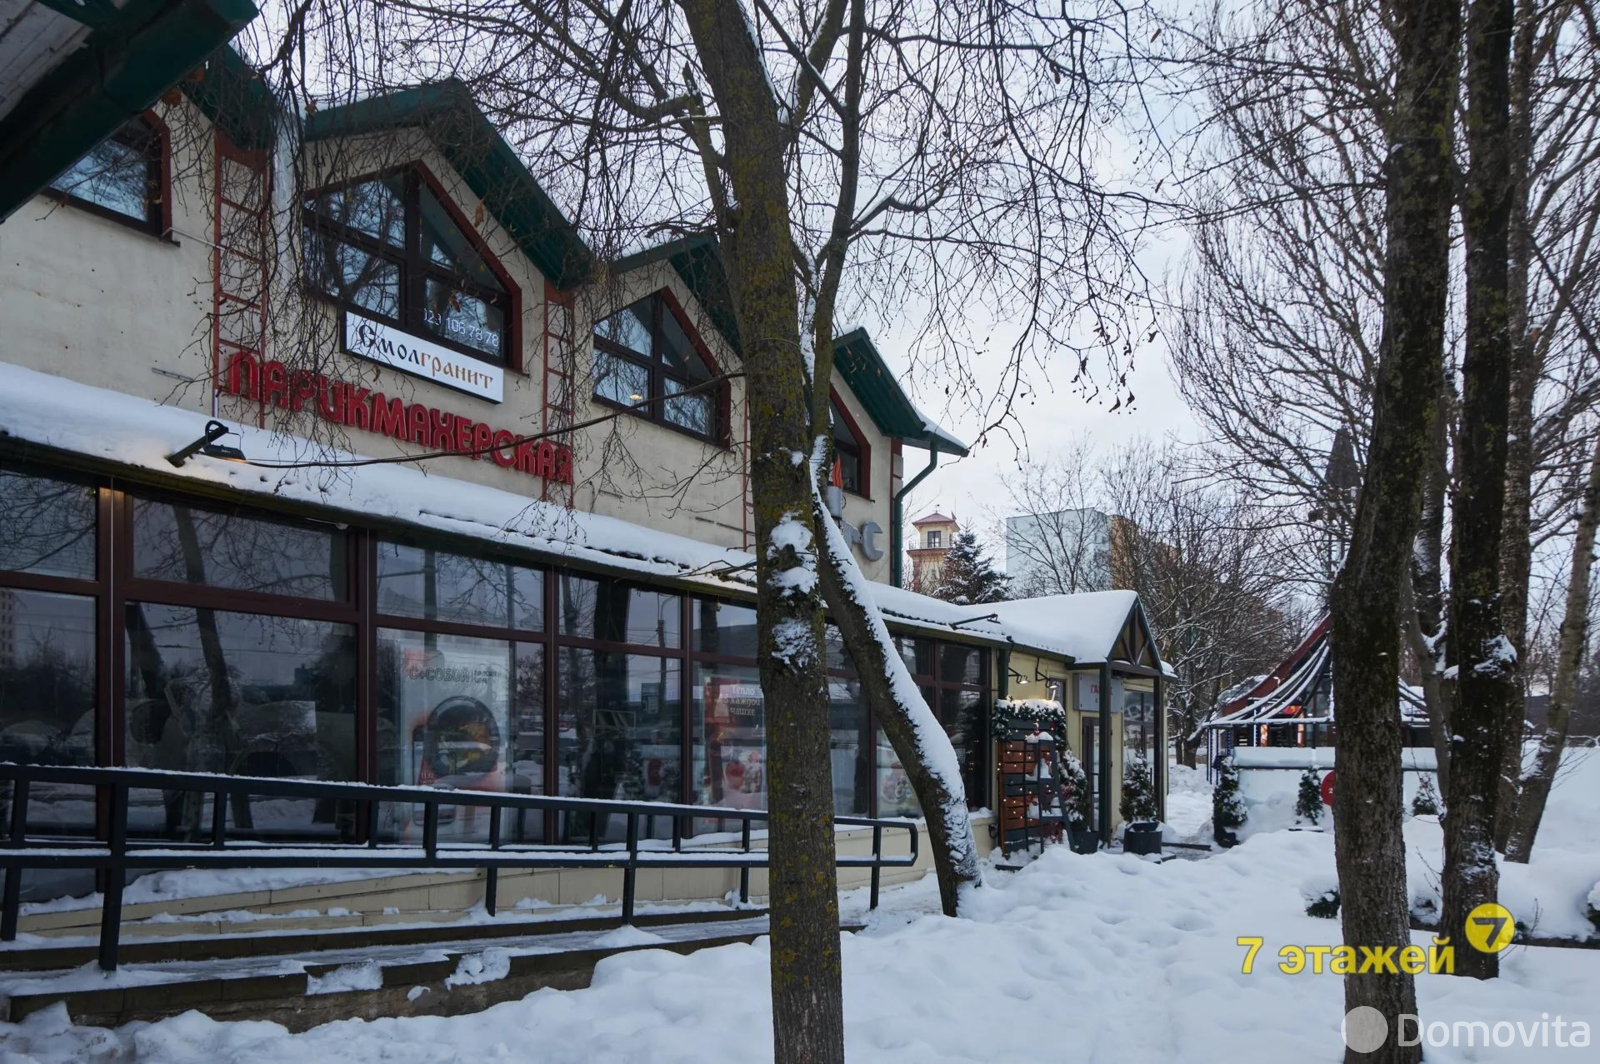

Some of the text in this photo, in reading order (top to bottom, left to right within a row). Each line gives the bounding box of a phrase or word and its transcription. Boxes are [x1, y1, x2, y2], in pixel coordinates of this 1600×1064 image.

[358, 324, 493, 389] Смолгранит
[486, 331, 499, 347] 78
[227, 351, 573, 485] ПАРИКМАХЕРСКАЯ
